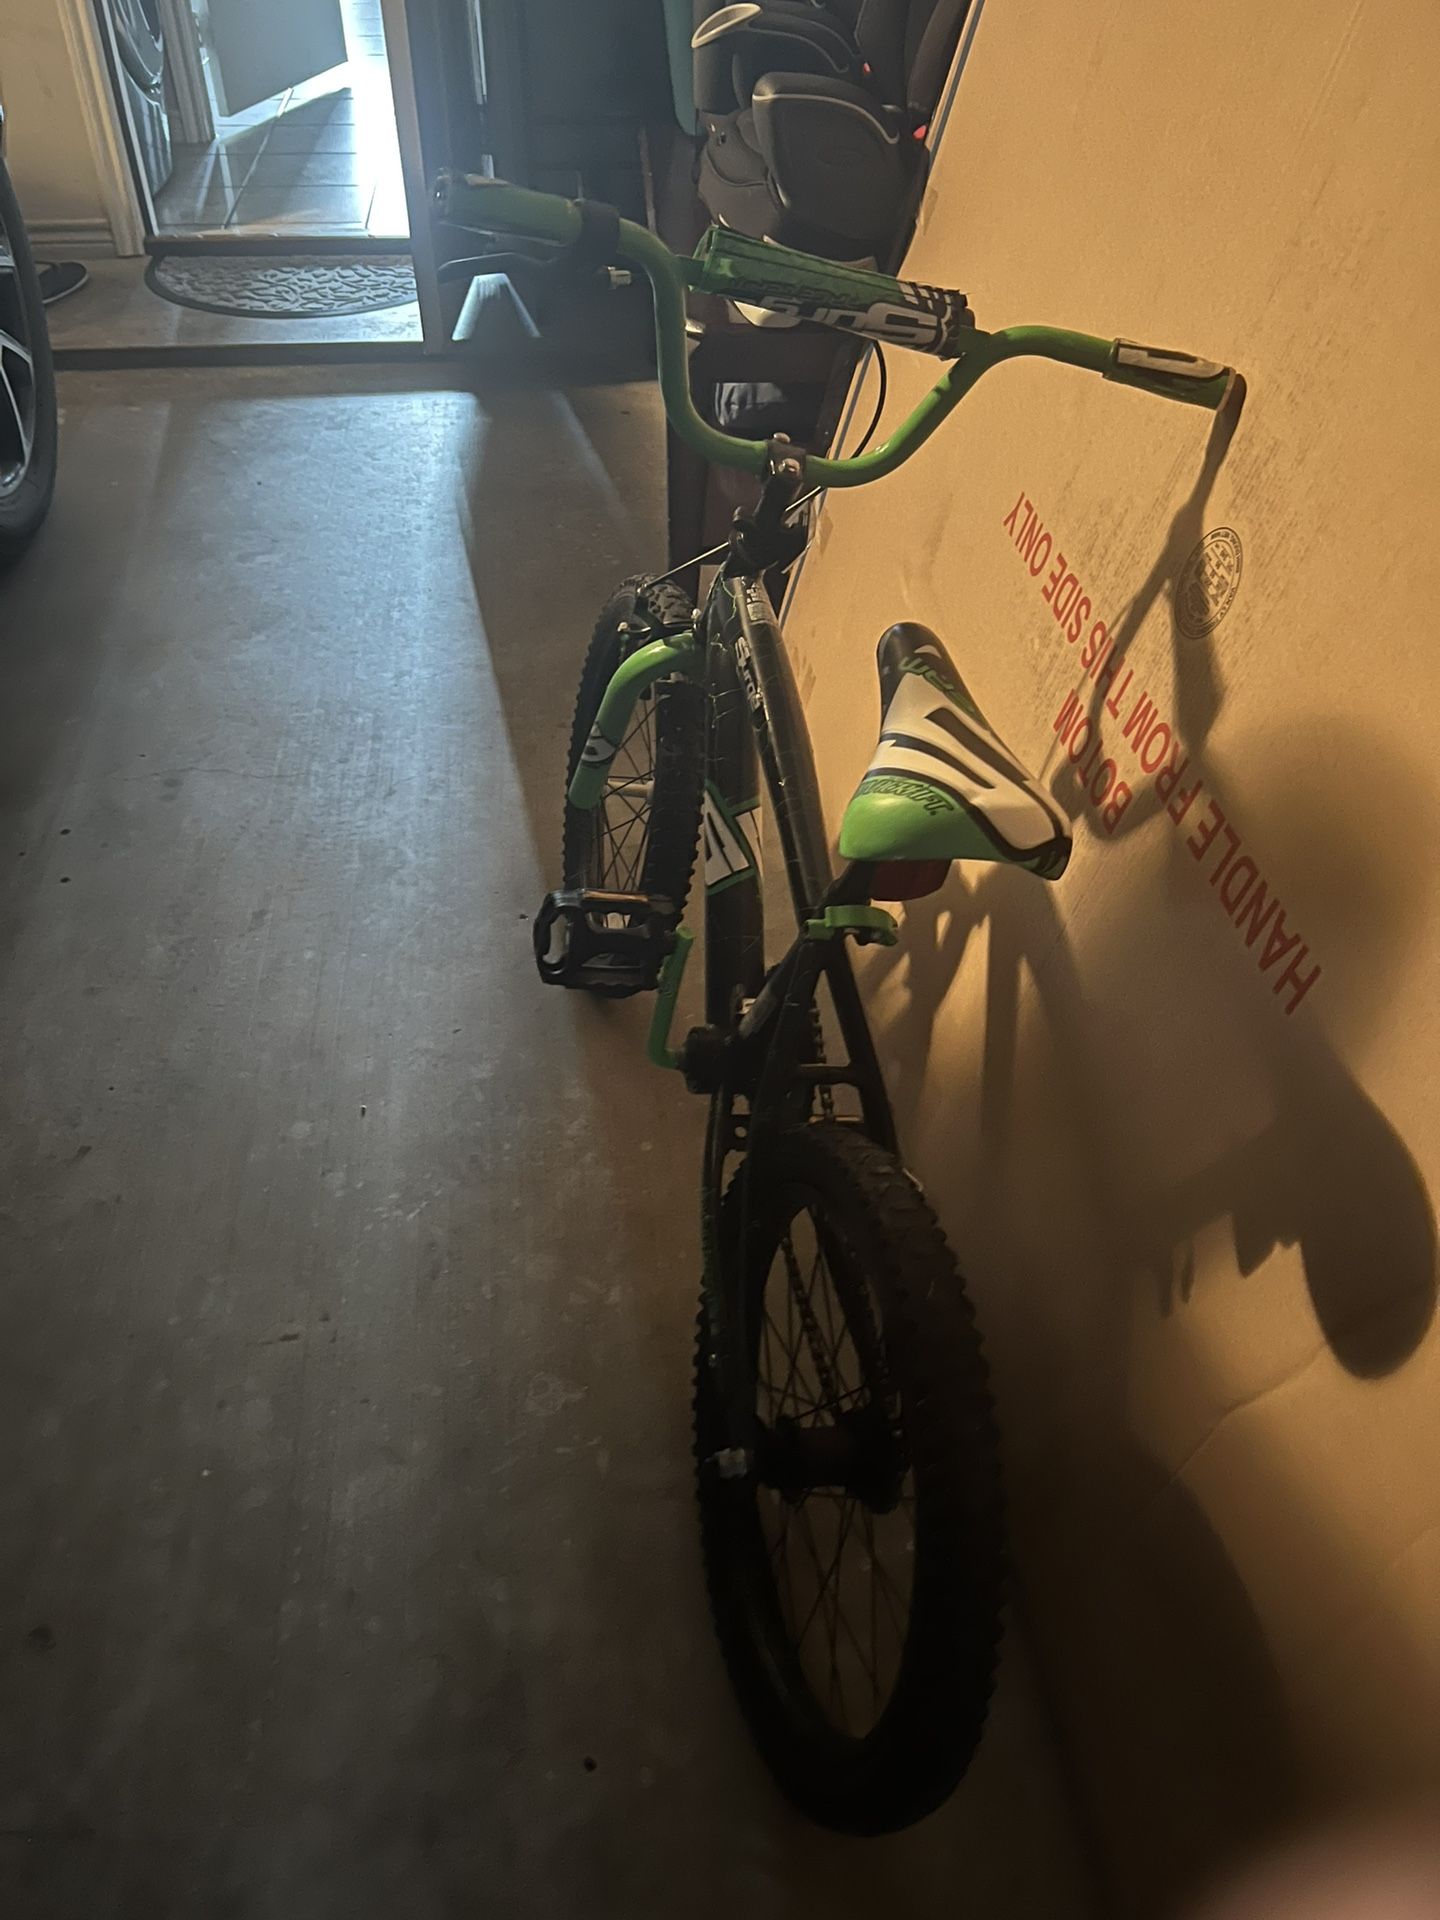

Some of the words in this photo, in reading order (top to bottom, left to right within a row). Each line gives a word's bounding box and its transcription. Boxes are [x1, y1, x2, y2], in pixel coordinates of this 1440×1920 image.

[1003, 491, 1052, 577] ONLY
[1041, 552, 1091, 644] SIDE
[1081, 620, 1134, 721] THIS
[1053, 688, 1133, 835] BOTOM
[1121, 690, 1204, 827] FROM
[1186, 799, 1322, 1016] HANDLE
